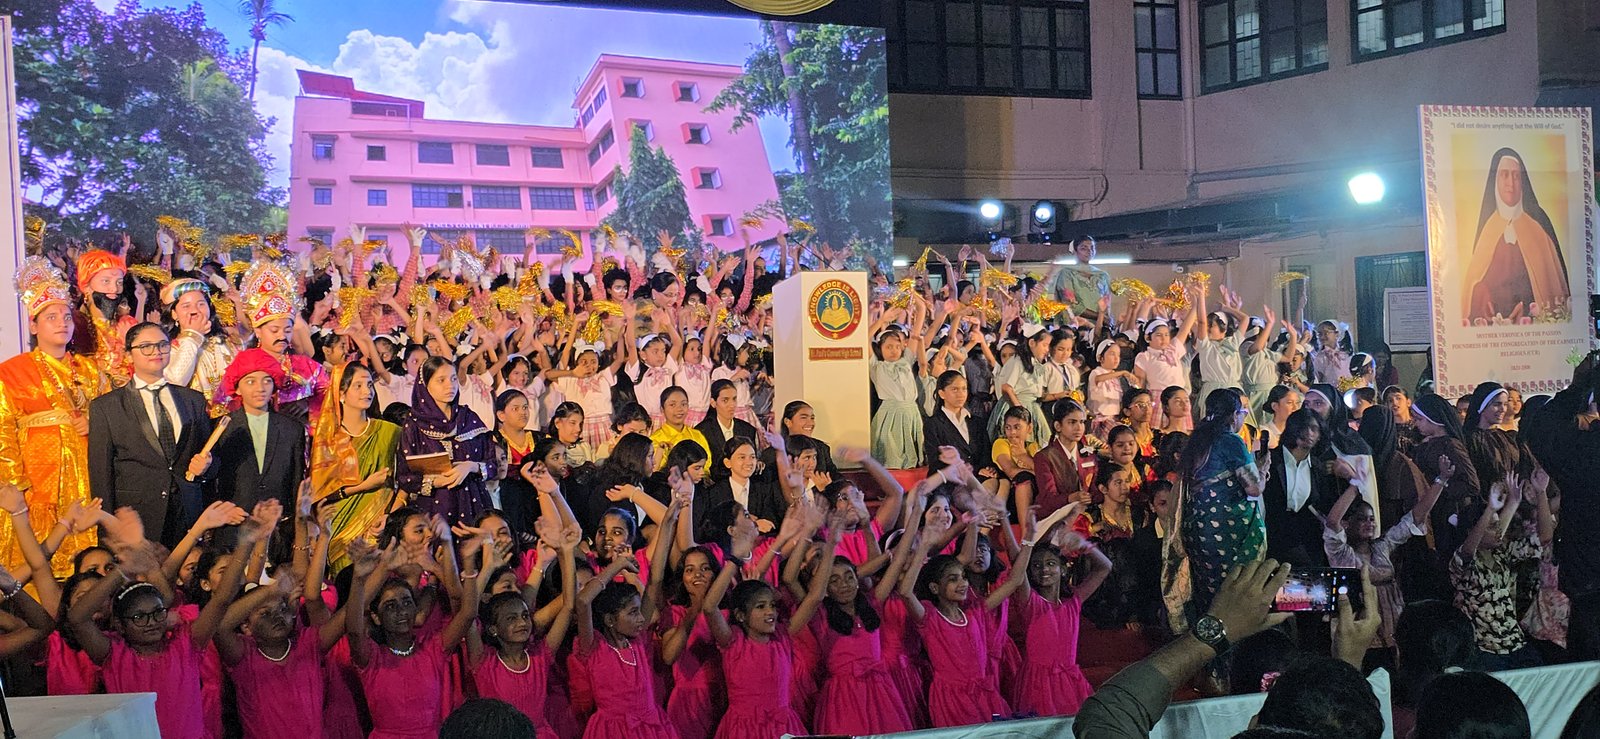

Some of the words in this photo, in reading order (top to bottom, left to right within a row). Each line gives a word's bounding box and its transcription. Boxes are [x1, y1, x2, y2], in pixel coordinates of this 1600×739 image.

[1492, 122, 1513, 130] anything
[810, 281, 842, 315] KNOWLEDGE
[842, 283, 850, 291] IS
[850, 291, 860, 316] LIGHT
